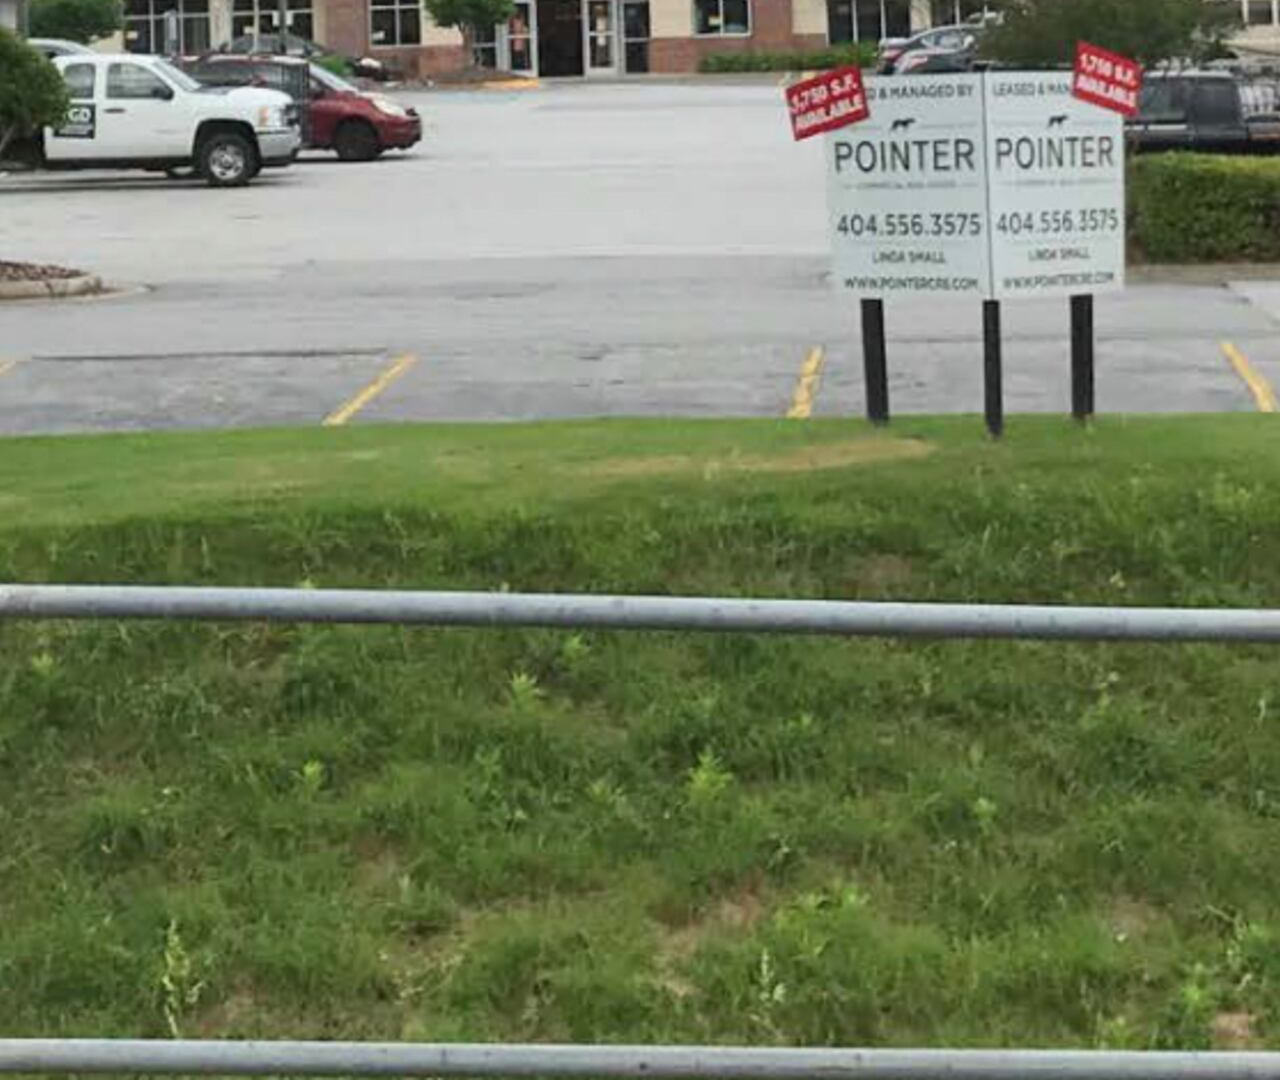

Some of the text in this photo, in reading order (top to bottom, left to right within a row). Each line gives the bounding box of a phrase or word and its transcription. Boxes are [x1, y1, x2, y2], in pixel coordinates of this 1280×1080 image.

[890, 84, 954, 99] MANAGED
[993, 82, 1035, 96] LEASED
[796, 94, 863, 130] AVAILABLE
[834, 139, 975, 173] POINTER
[996, 136, 1114, 170] POINTER
[837, 214, 981, 236] 404.556.3575
[996, 209, 1118, 234] 404.556.3575
[909, 250, 946, 263] SMALL
